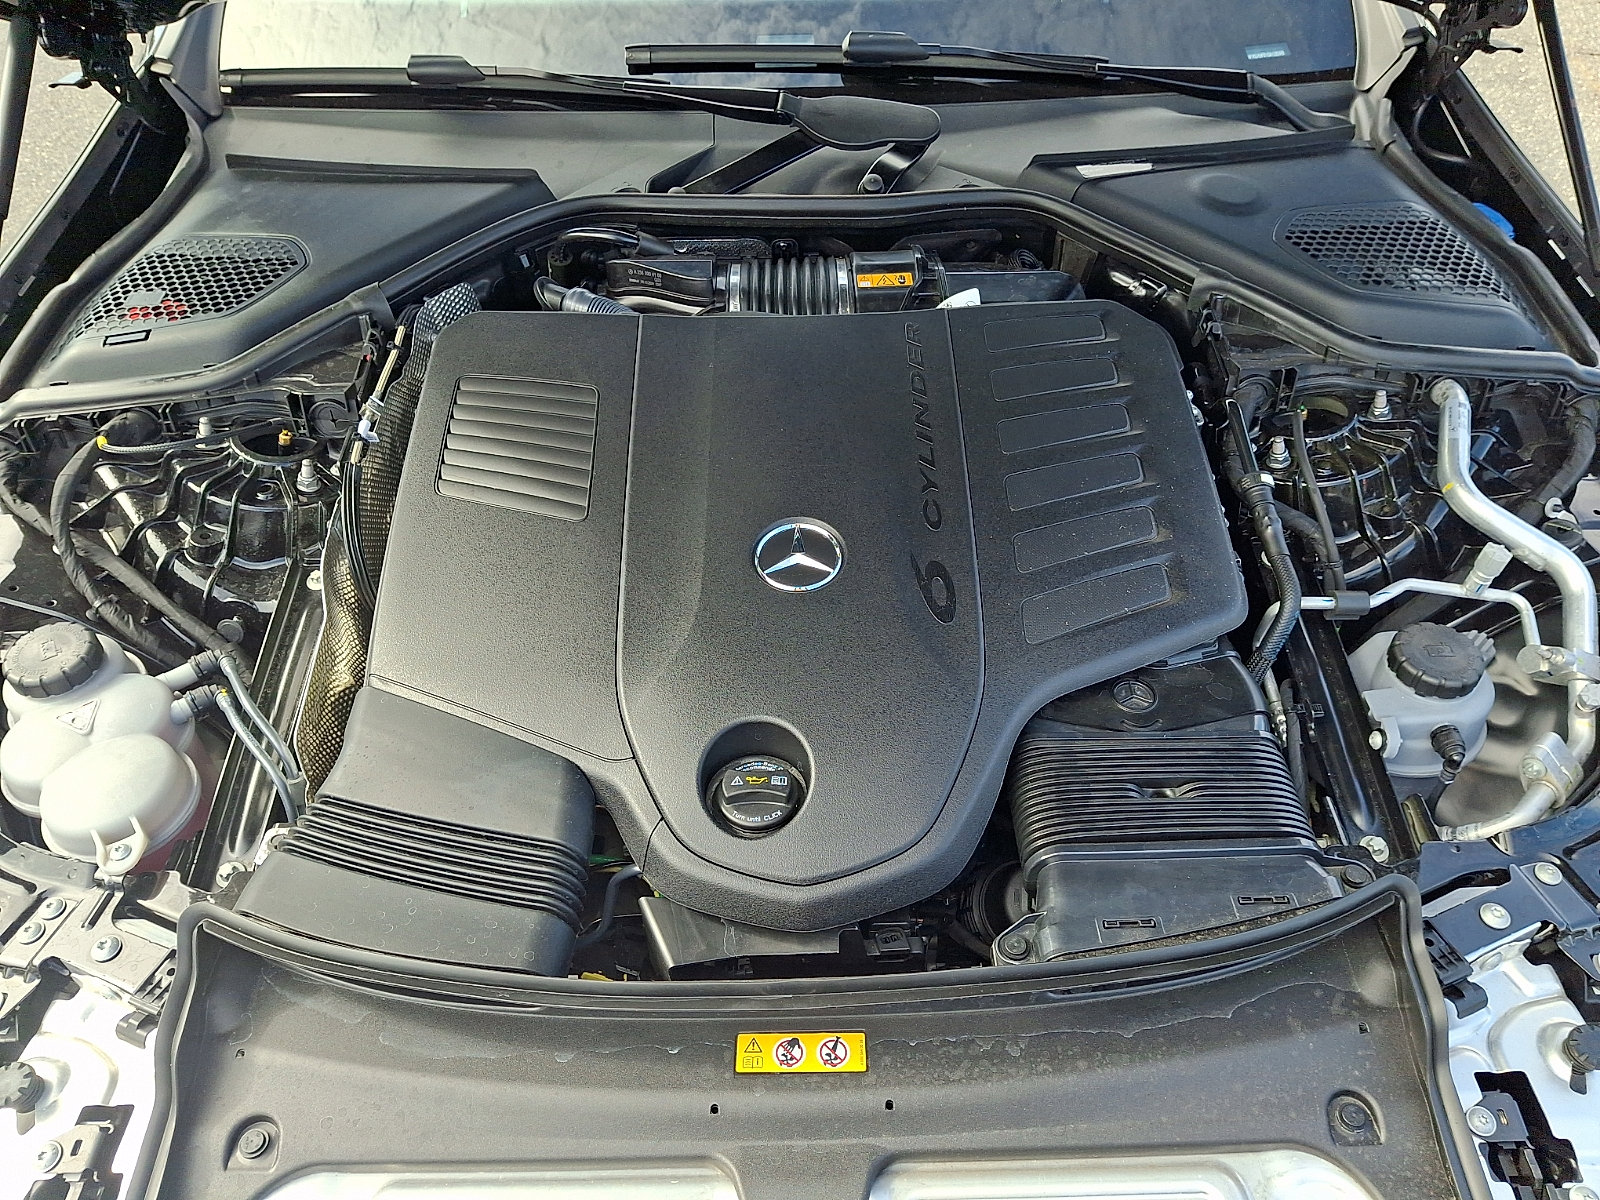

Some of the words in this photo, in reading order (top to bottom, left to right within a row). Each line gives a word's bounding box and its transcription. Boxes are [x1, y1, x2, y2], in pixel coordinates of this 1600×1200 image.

[904, 321, 943, 532] CYLINDER
[910, 552, 957, 625] 6
[732, 810, 745, 820] Turn
[764, 810, 782, 820] CLICK
